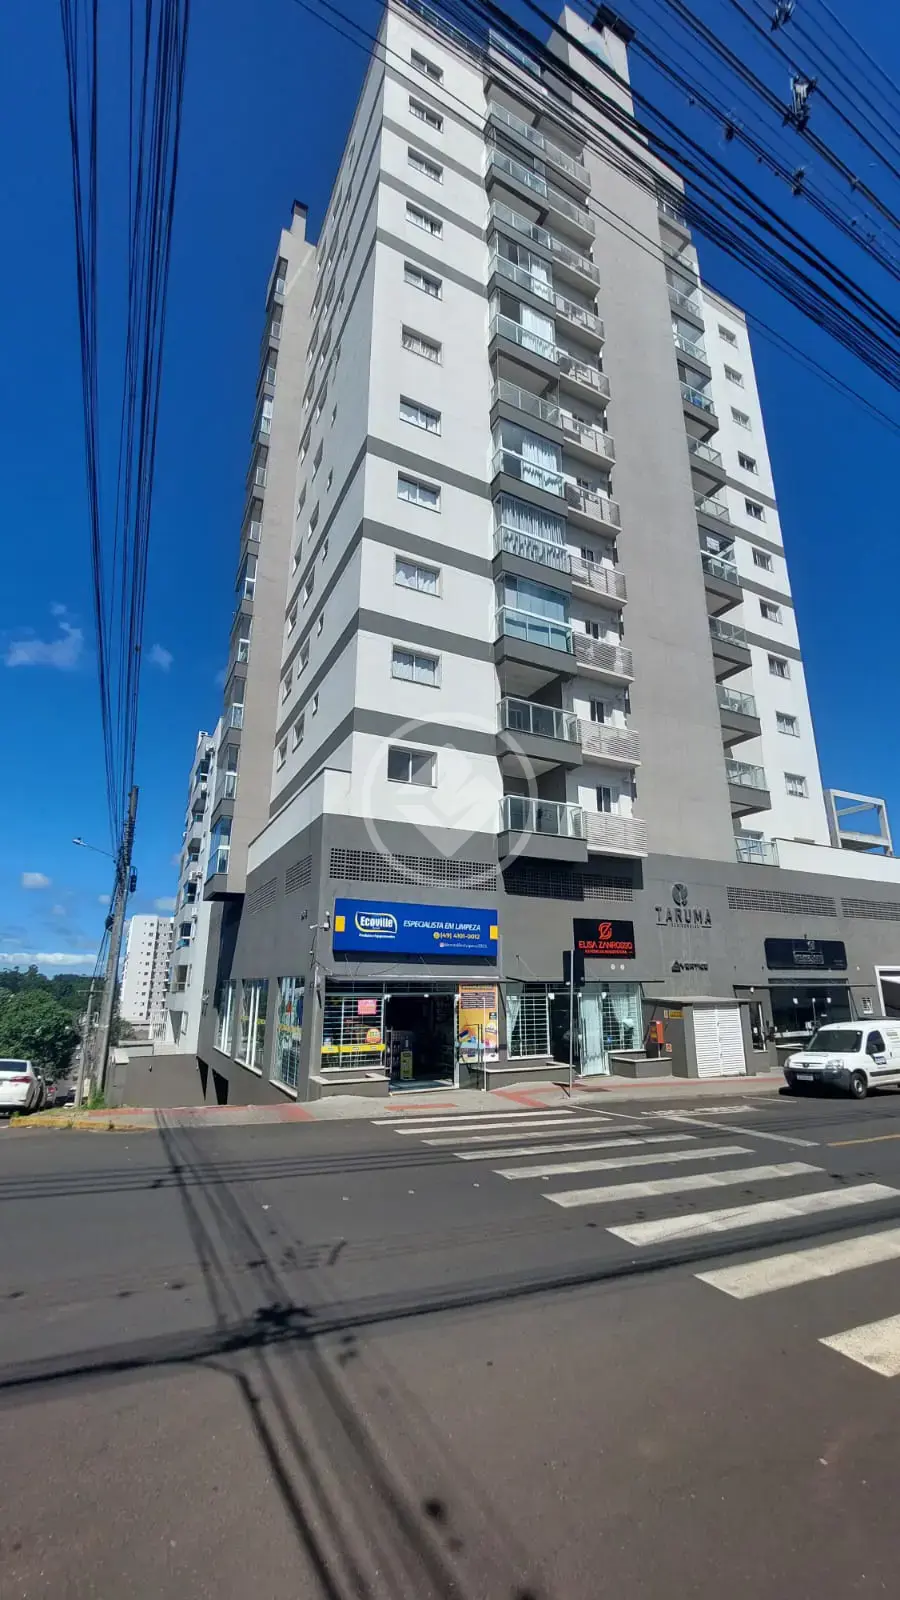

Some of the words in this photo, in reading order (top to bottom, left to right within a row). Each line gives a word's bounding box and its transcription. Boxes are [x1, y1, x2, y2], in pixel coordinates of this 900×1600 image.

[655, 906, 712, 925] TARUMA
[360, 916, 393, 928] Ecoville
[403, 920, 443, 930] ESPECIALISTA
[444, 922, 455, 930] EM
[455, 923, 481, 931] LIMPEZA
[578, 940, 598, 949] ELISA
